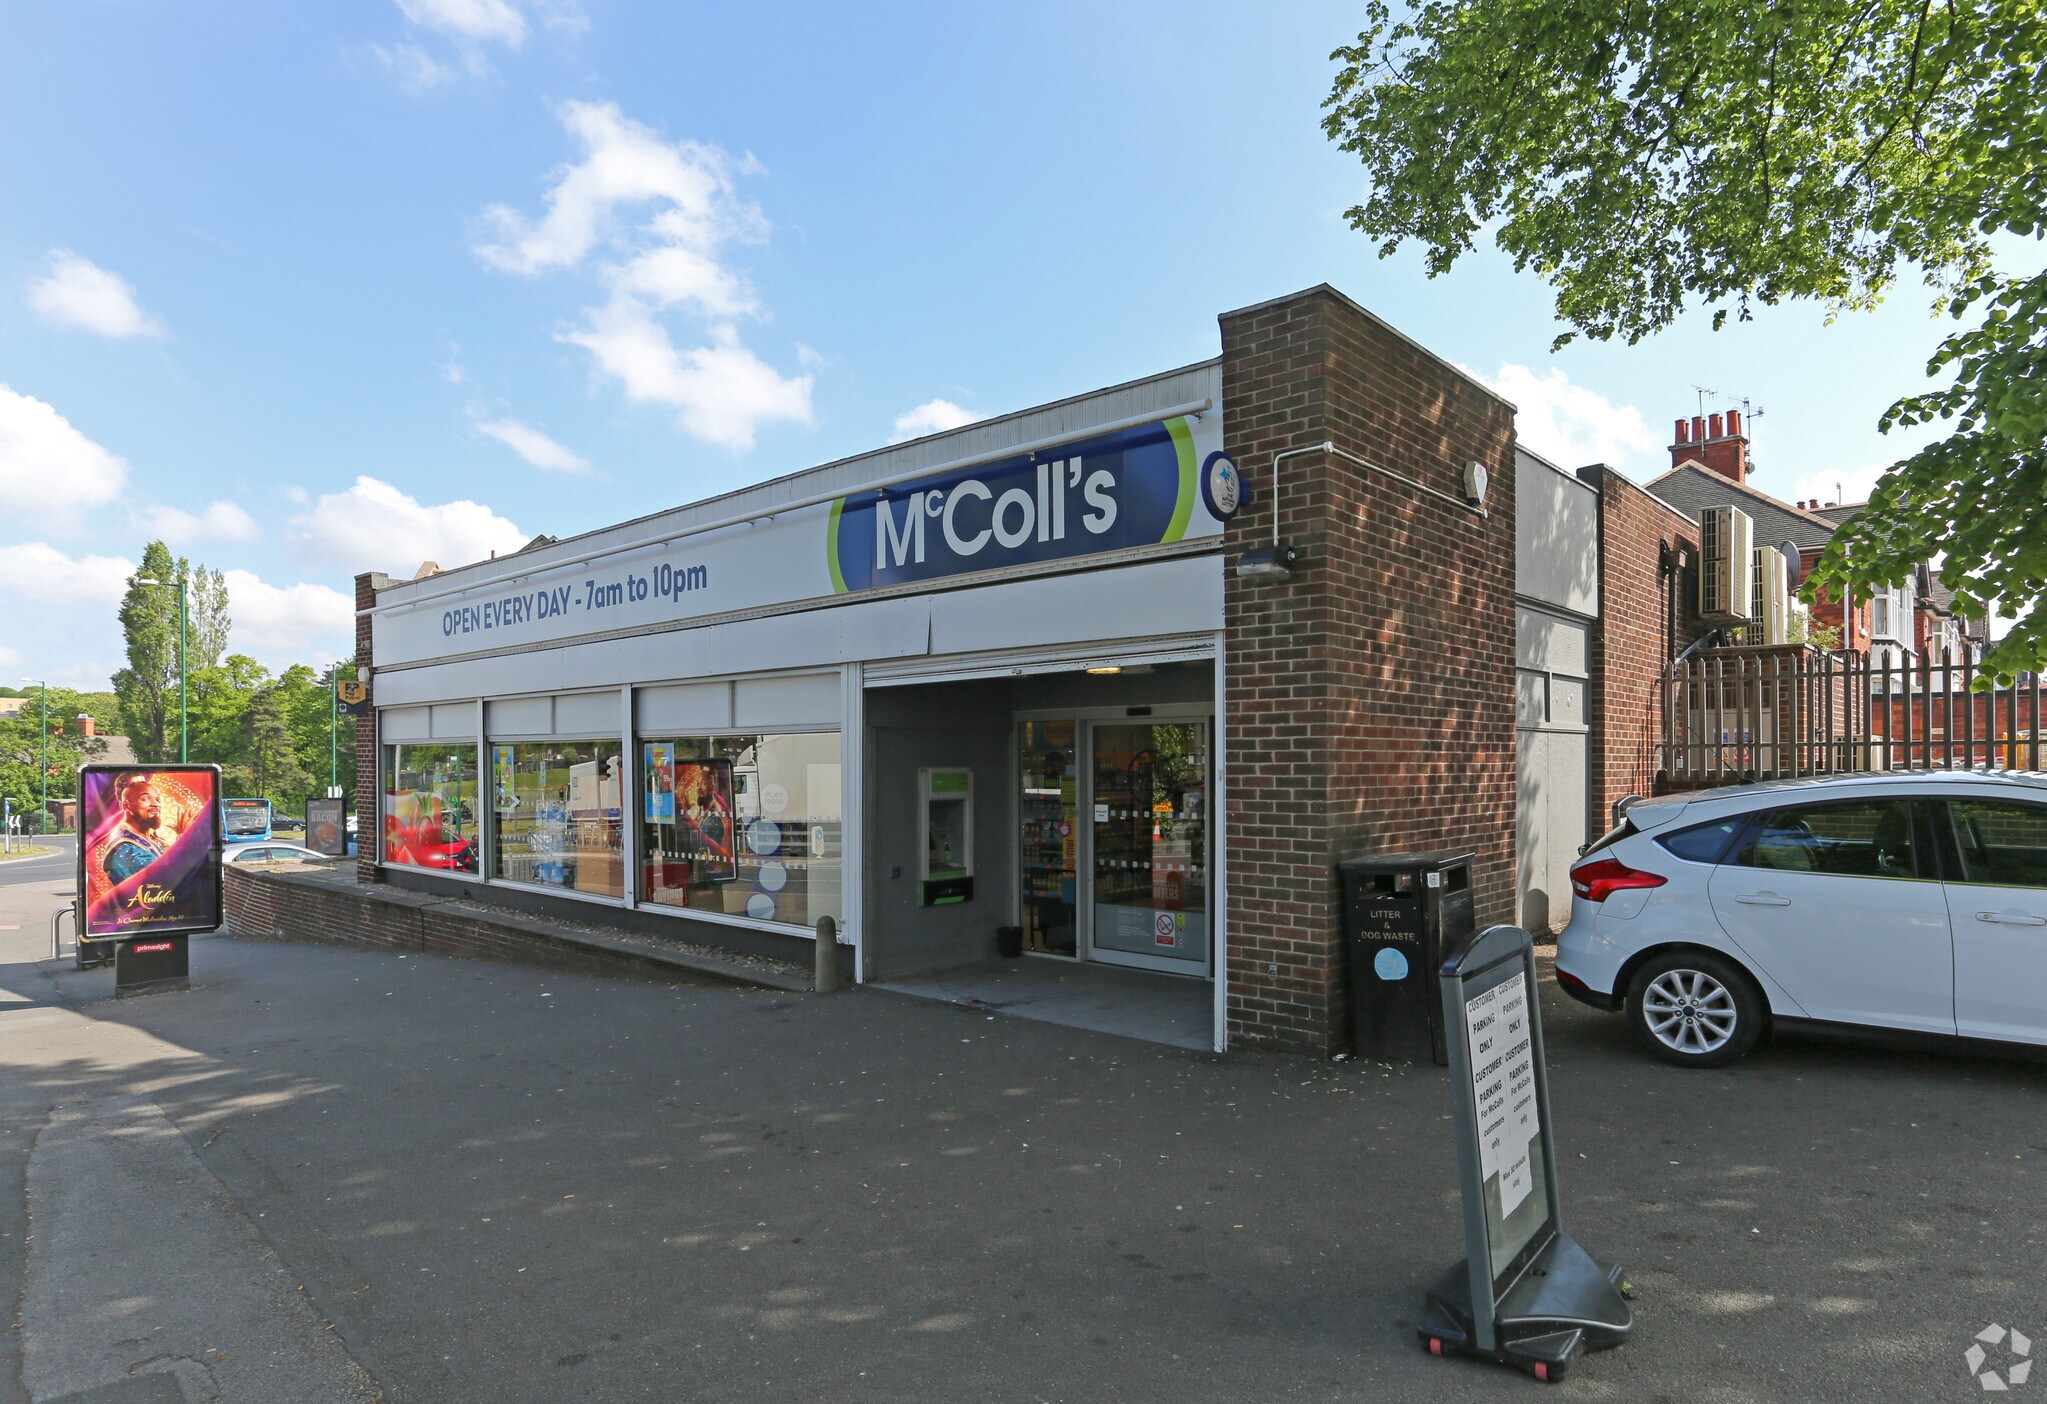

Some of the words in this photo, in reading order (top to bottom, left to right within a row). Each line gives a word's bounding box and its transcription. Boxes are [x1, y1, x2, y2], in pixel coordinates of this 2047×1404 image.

[876, 456, 1118, 571] McColl's
[443, 604, 481, 637] OPEN
[483, 593, 534, 630] EVERY
[537, 584, 572, 620] DAY
[585, 579, 623, 611] 7am
[627, 574, 648, 602] to
[652, 563, 707, 603] 10pm
[311, 813, 338, 823] BACON
[127, 885, 175, 910] Aladdin
[653, 889, 683, 903] SAVINGS
[1153, 887, 1179, 900] OFFERS
[1370, 910, 1401, 919] LITTER
[1384, 921, 1390, 929] &
[1361, 931, 1381, 939] DOG
[1383, 932, 1415, 941] WASTE
[137, 943, 170, 952] primesight
[1498, 975, 1523, 995] CUSTOMER
[1468, 990, 1496, 1013] CUSTOMER
[1502, 996, 1523, 1015] PARKING
[1472, 1013, 1496, 1034] PARKING
[1508, 1018, 1521, 1034] ONLY
[1480, 1036, 1494, 1053] ONLY
[1505, 1038, 1529, 1062] CUSTOMER
[1475, 1056, 1502, 1083] CUSTOMER
[1509, 1060, 1529, 1082] PARKING
[1479, 1079, 1503, 1104] PARKING
[1510, 1086, 1518, 1096] For
[1513, 1094, 1532, 1113] customers
[1483, 1116, 1505, 1137] customers
[1491, 1137, 1501, 1149] only
